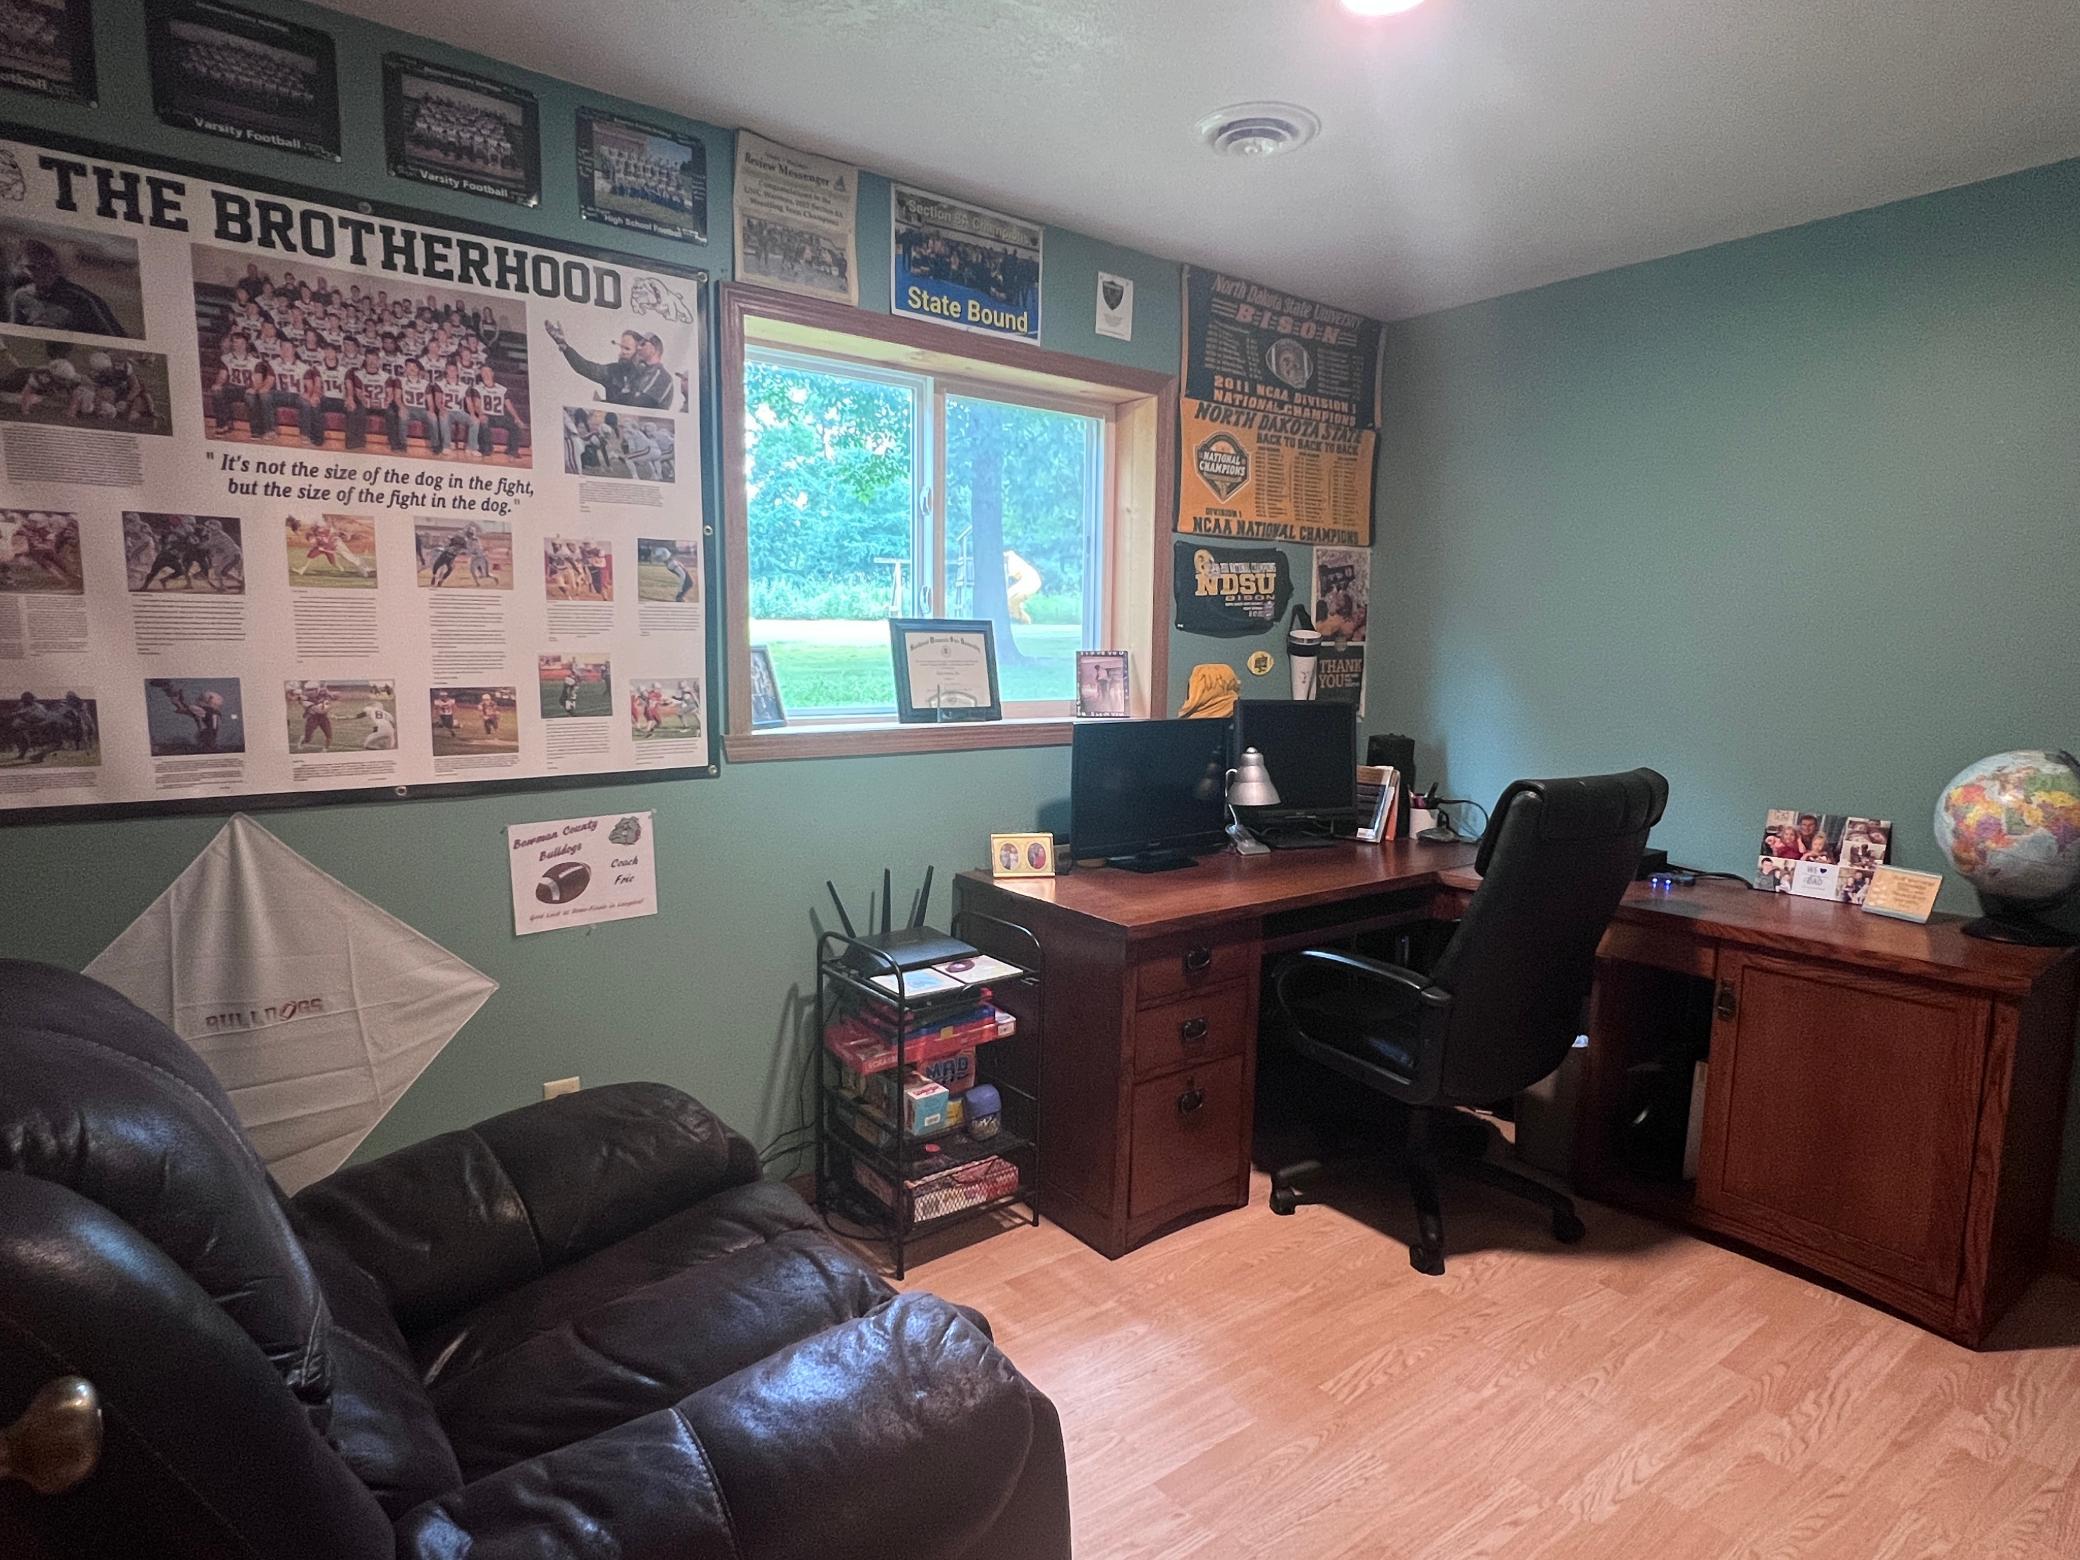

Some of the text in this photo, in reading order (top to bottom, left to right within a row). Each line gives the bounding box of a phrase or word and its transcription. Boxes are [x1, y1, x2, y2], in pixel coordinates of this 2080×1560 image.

[194, 117, 300, 149] Varsity Football
[419, 169, 508, 198] Varsity Football
[744, 152, 776, 171] Review
[778, 162, 830, 186] Messenger
[907, 200, 951, 222] Section
[38, 154, 622, 310] THE BROTHERHOOD
[907, 286, 1028, 333] State Bound
[1211, 274, 1246, 297] North
[1247, 285, 1283, 311] Dakota
[1284, 296, 1313, 317] State
[1213, 388, 1356, 427] NATIONAL CHAMPIONS
[1214, 375, 1249, 393] 2011
[1256, 384, 1289, 402] NCAA
[1294, 391, 1349, 413] DIVISION
[1194, 401, 1363, 445] NORTH DAKOTA STATE
[1203, 449, 1240, 466] NATIONAL
[1256, 433, 1282, 447] BACK
[1297, 438, 1324, 453] BACK
[220, 453, 249, 473] It's
[255, 460, 286, 476] not
[291, 459, 319, 478] the
[324, 466, 357, 481] size
[362, 466, 383, 486] of
[384, 466, 410, 485] the
[415, 470, 443, 490] dog
[448, 473, 464, 489] in
[468, 473, 493, 492] the
[498, 477, 535, 498] fight,
[1199, 460, 1246, 477] CHAMPIONS
[228, 478, 520, 515] but the size of the fight in the dog."
[1193, 516, 1359, 545] NCAA NATIONAL CHAMPIONS
[1195, 573, 1277, 597] NDSU
[1319, 659, 1363, 675] THANK
[1319, 674, 1345, 689] YOU
[513, 820, 599, 850] Bowman County
[539, 843, 583, 861] Bulldogs
[610, 856, 639, 868] Coach
